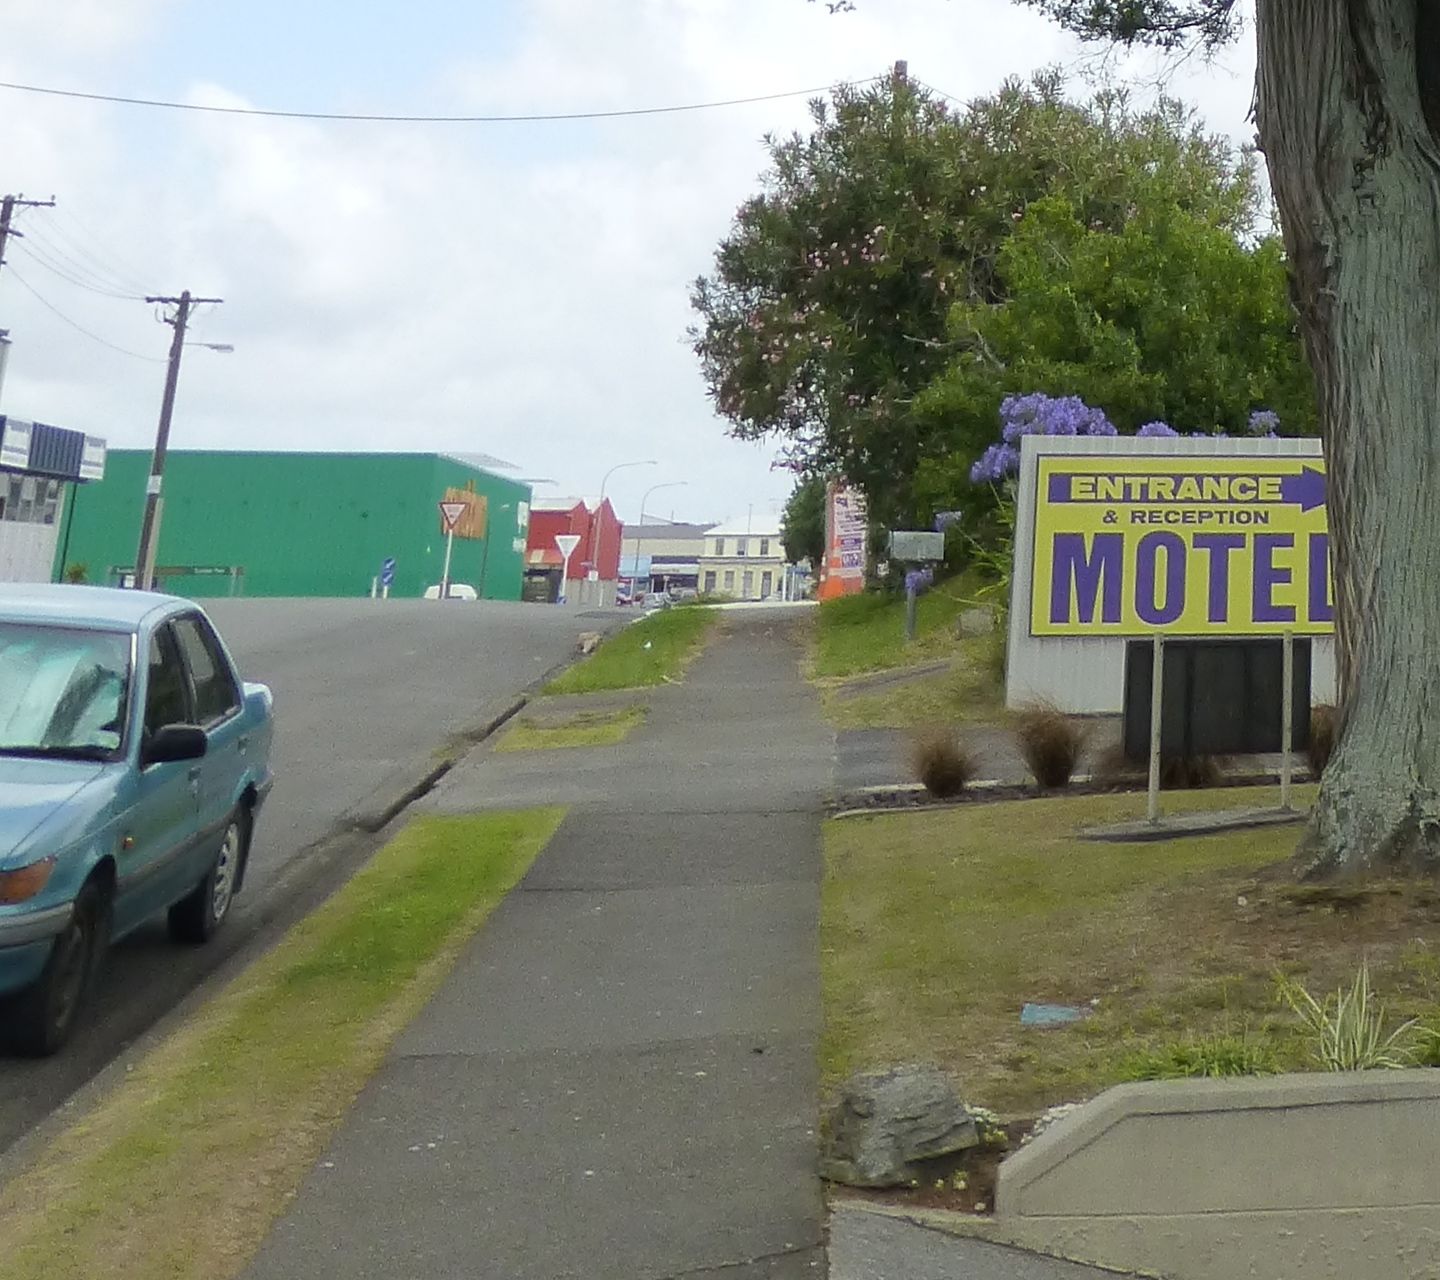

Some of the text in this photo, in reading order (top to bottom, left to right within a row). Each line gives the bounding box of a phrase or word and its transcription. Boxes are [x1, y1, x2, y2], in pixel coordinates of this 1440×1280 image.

[1071, 476, 1282, 501] ENTRANCE
[1102, 510, 1269, 524] & RECEPTION
[1050, 531, 1335, 624] MOTEL
